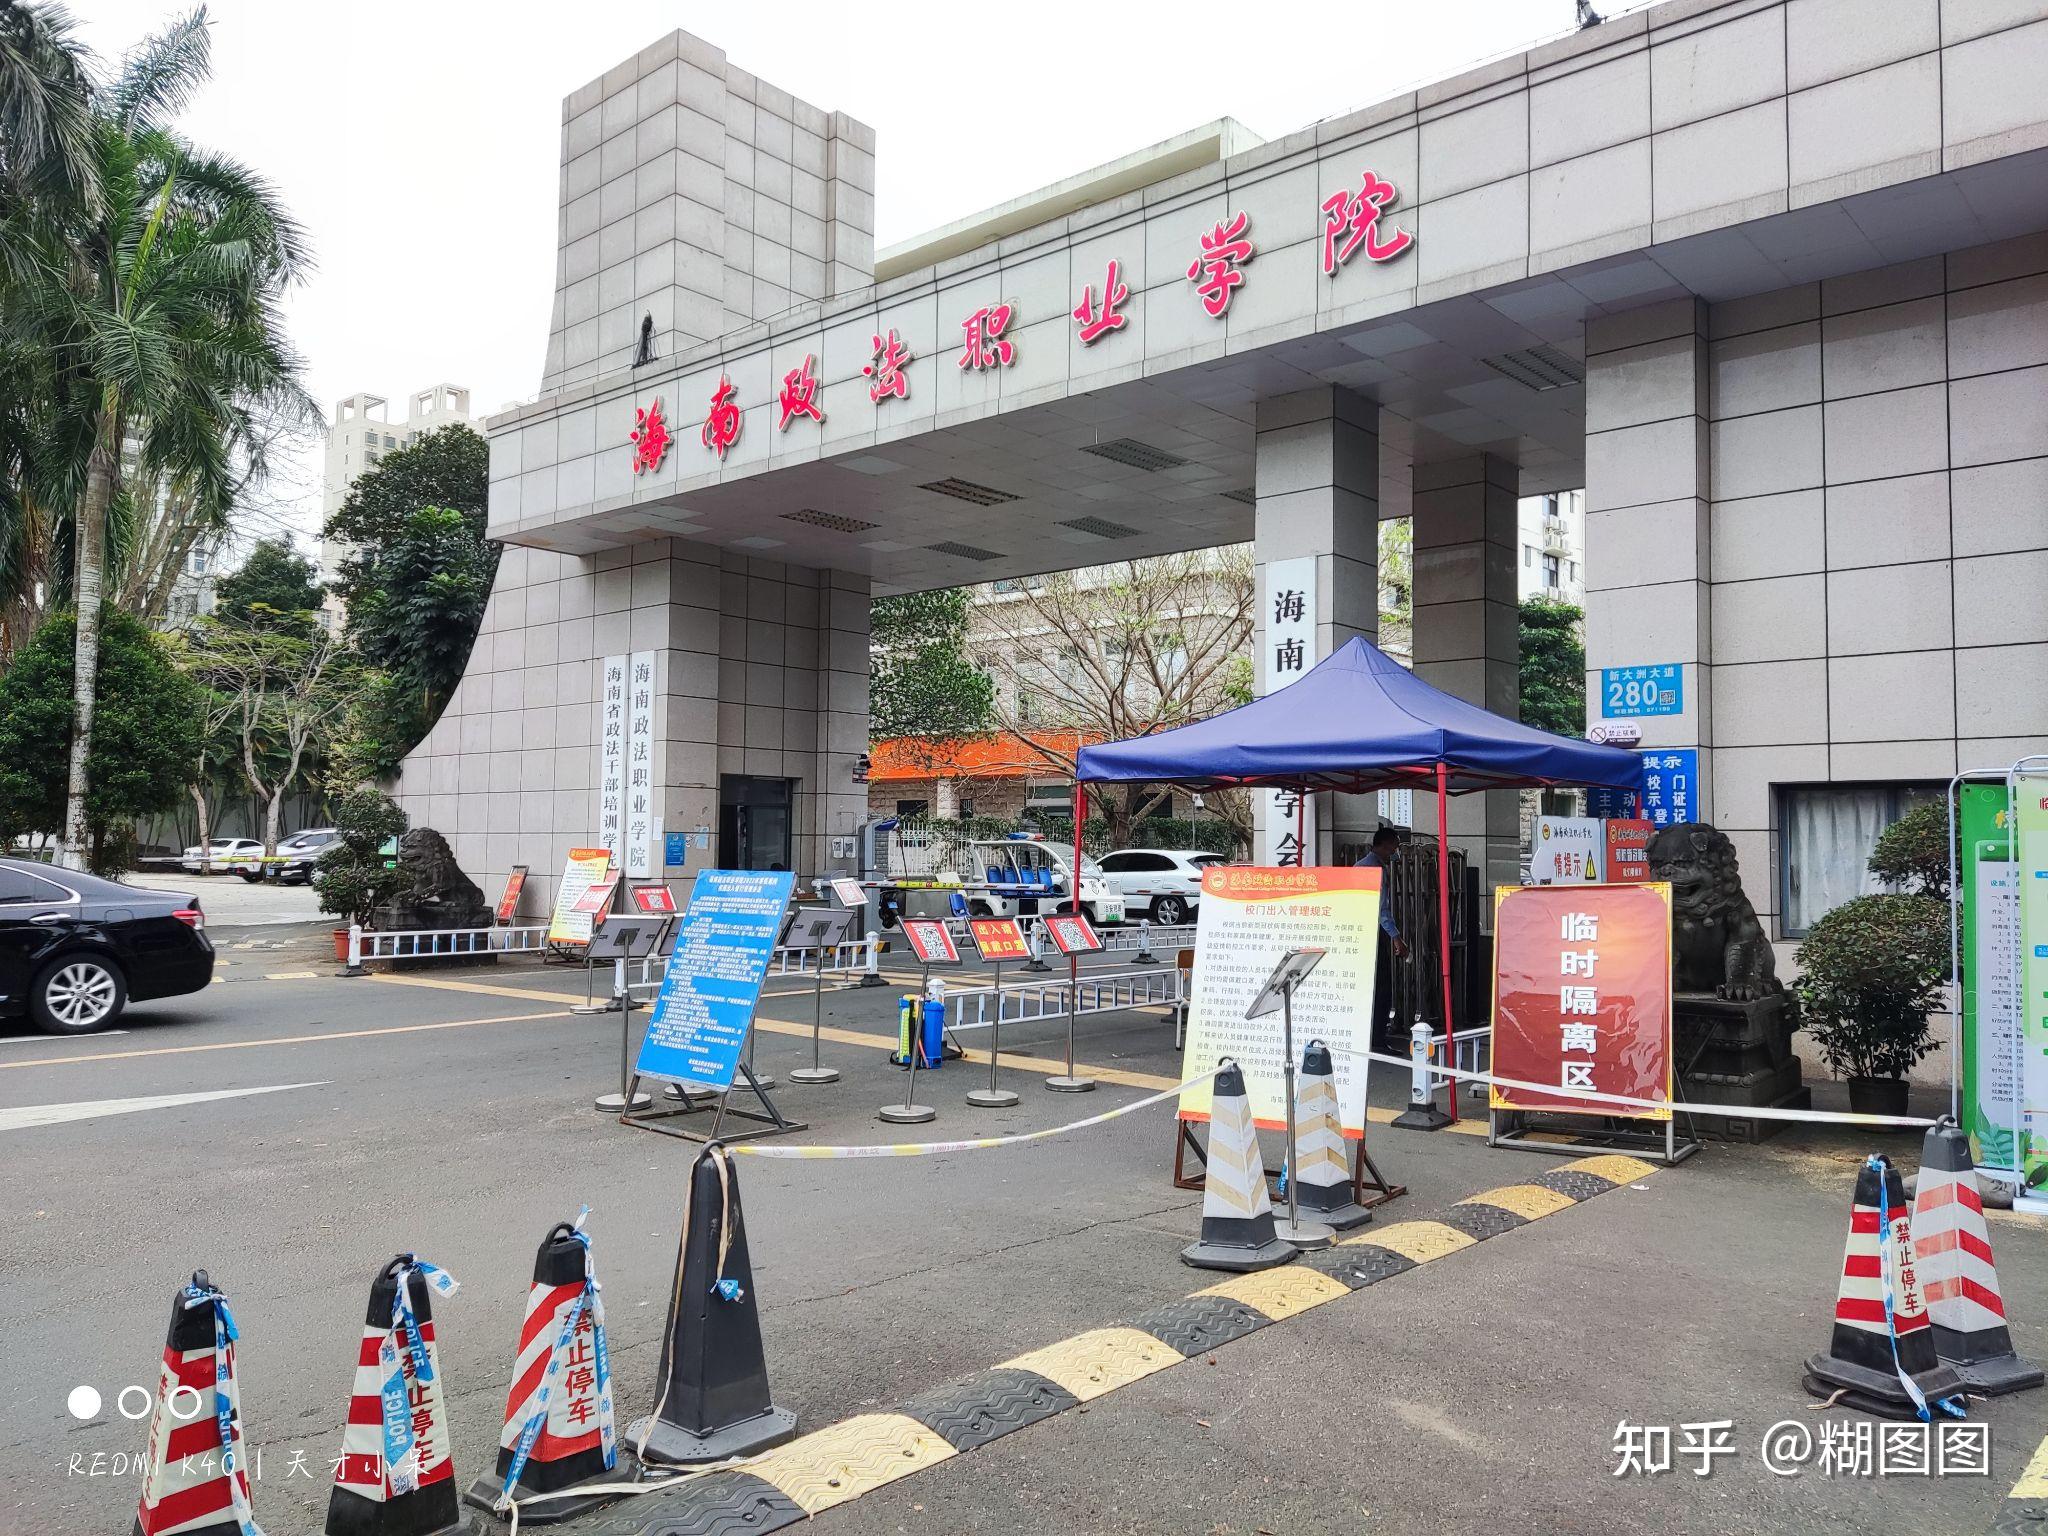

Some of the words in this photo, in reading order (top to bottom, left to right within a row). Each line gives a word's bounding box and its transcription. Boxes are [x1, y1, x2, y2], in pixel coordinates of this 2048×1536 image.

[630, 169, 1413, 476] 海南政法职业学院
[1274, 589, 1306, 867] 海南学会
[1608, 666, 1675, 681] 新大洲大道
[1608, 680, 1658, 707] 280
[603, 666, 622, 868] 海南省政法干部培训学院
[630, 662, 650, 868] 海南政法职业学院
[1245, 903, 1332, 918] 校门出入管理规定
[1560, 912, 1599, 1091] 临时隔离区
[1895, 1222, 1919, 1314] 禁止停车
[564, 1307, 596, 1425] 禁止停车
